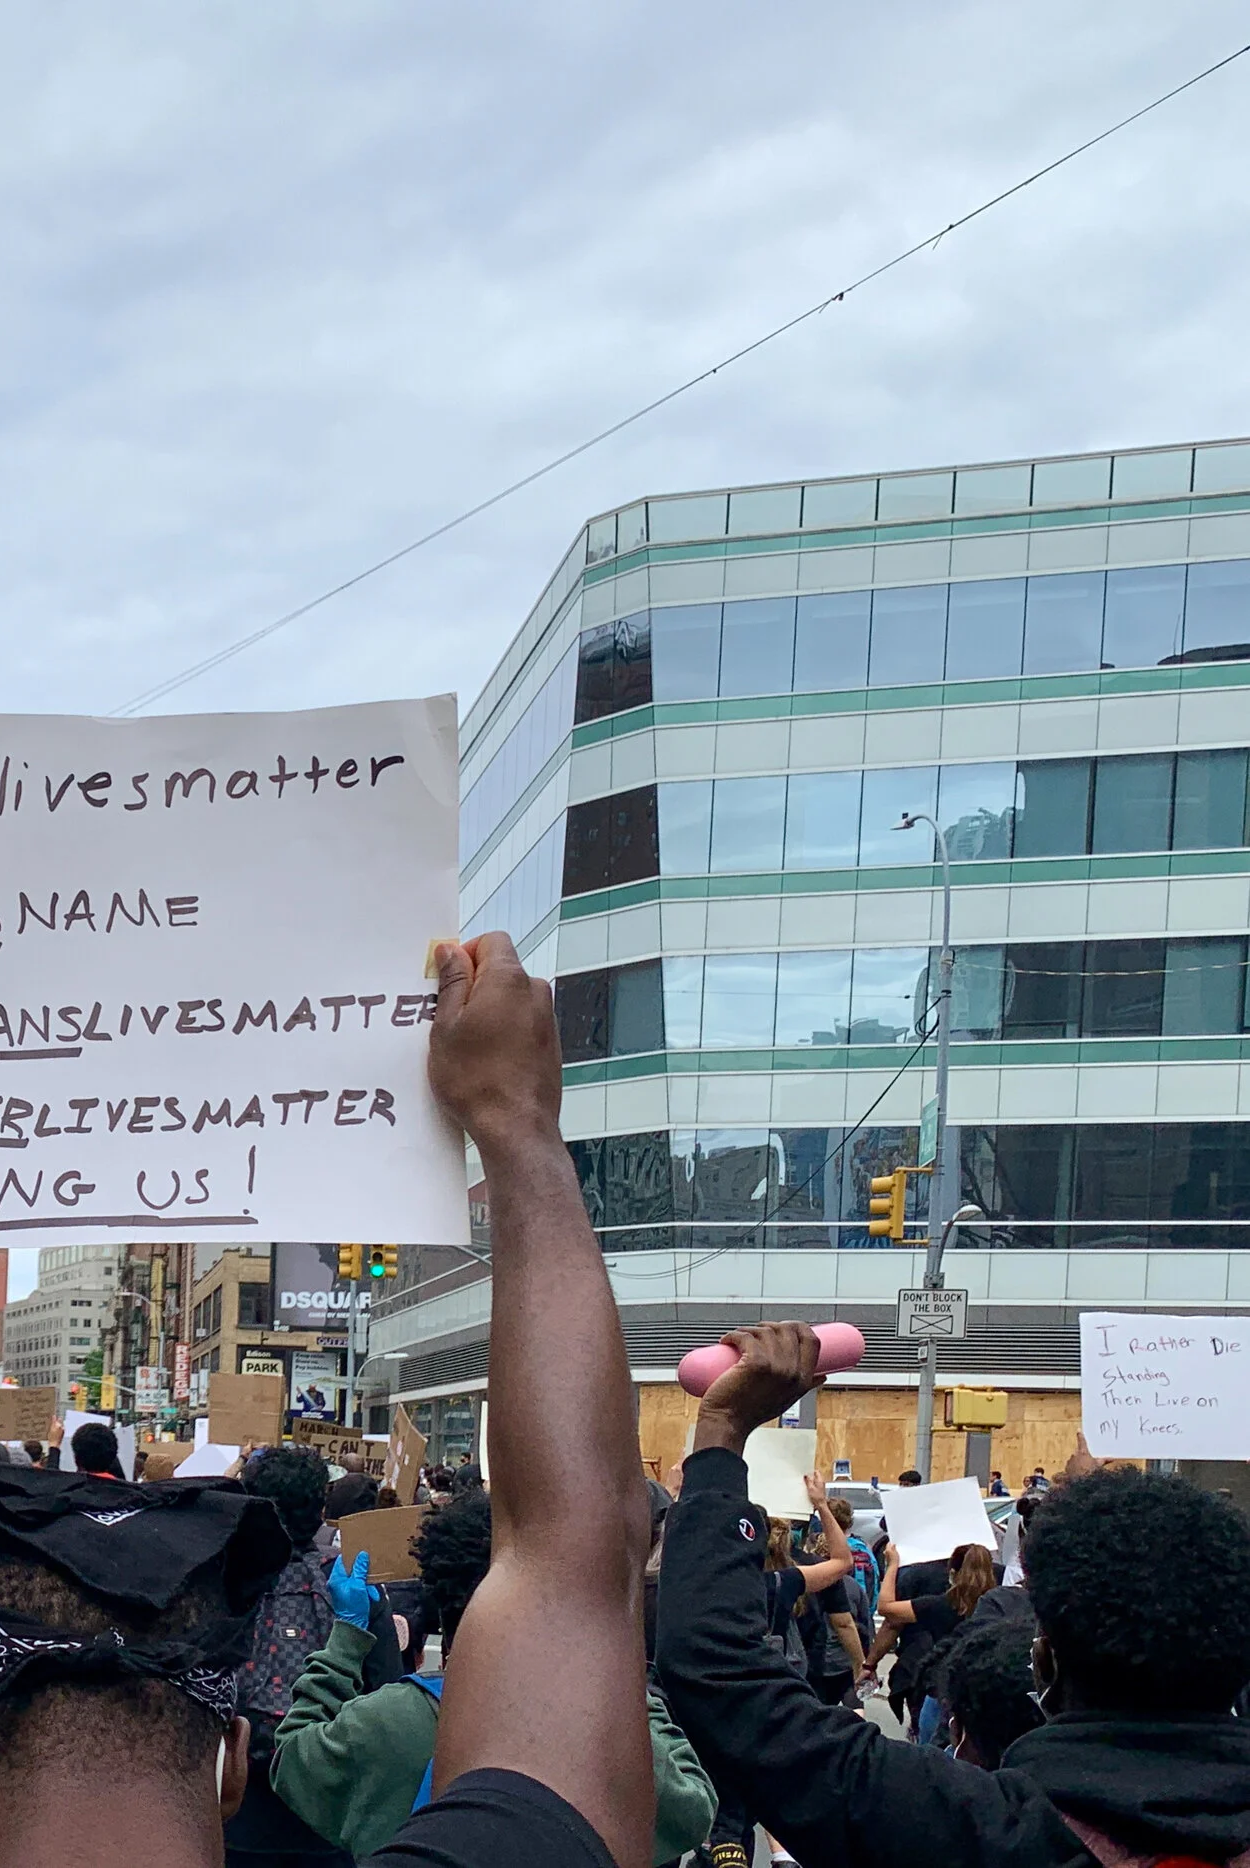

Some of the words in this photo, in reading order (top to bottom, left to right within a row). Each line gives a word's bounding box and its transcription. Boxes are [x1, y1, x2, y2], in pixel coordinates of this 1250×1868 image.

[903, 1293, 930, 1302] DON'T
[932, 1293, 963, 1302] BLOCK
[913, 1303, 930, 1312] THE
[933, 1304, 952, 1313] BOX
[1094, 1324, 1117, 1357] I
[245, 1363, 279, 1373] PARK
[1102, 1365, 1170, 1388] Standing
[1101, 1389, 1142, 1408] Then
[1196, 1397, 1219, 1408] on
[328, 1440, 375, 1457] CAN'T
